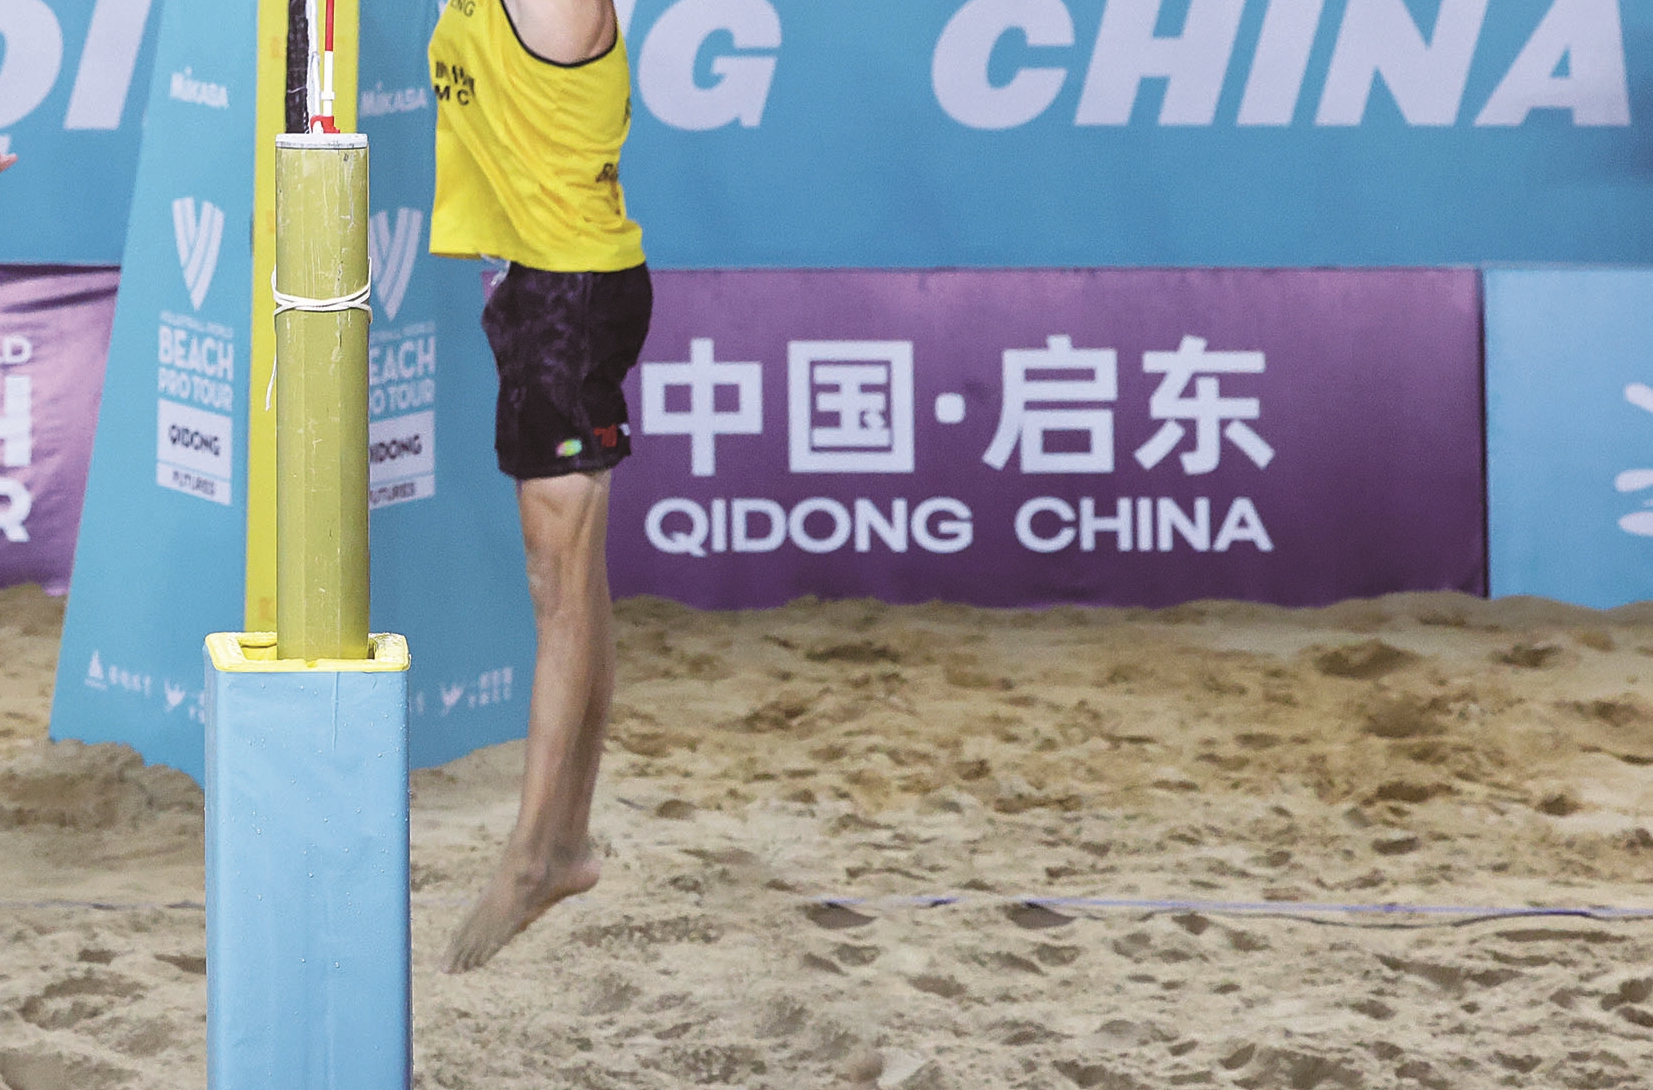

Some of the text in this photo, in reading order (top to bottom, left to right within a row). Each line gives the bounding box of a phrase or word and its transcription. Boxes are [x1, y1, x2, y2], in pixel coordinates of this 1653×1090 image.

[159, 325, 235, 383] BEACH
[369, 336, 436, 387] EACH
[158, 367, 234, 411] PRO TOUR
[168, 423, 221, 457] QIDONG
[645, 498, 1272, 557] QIDONG CHINA
